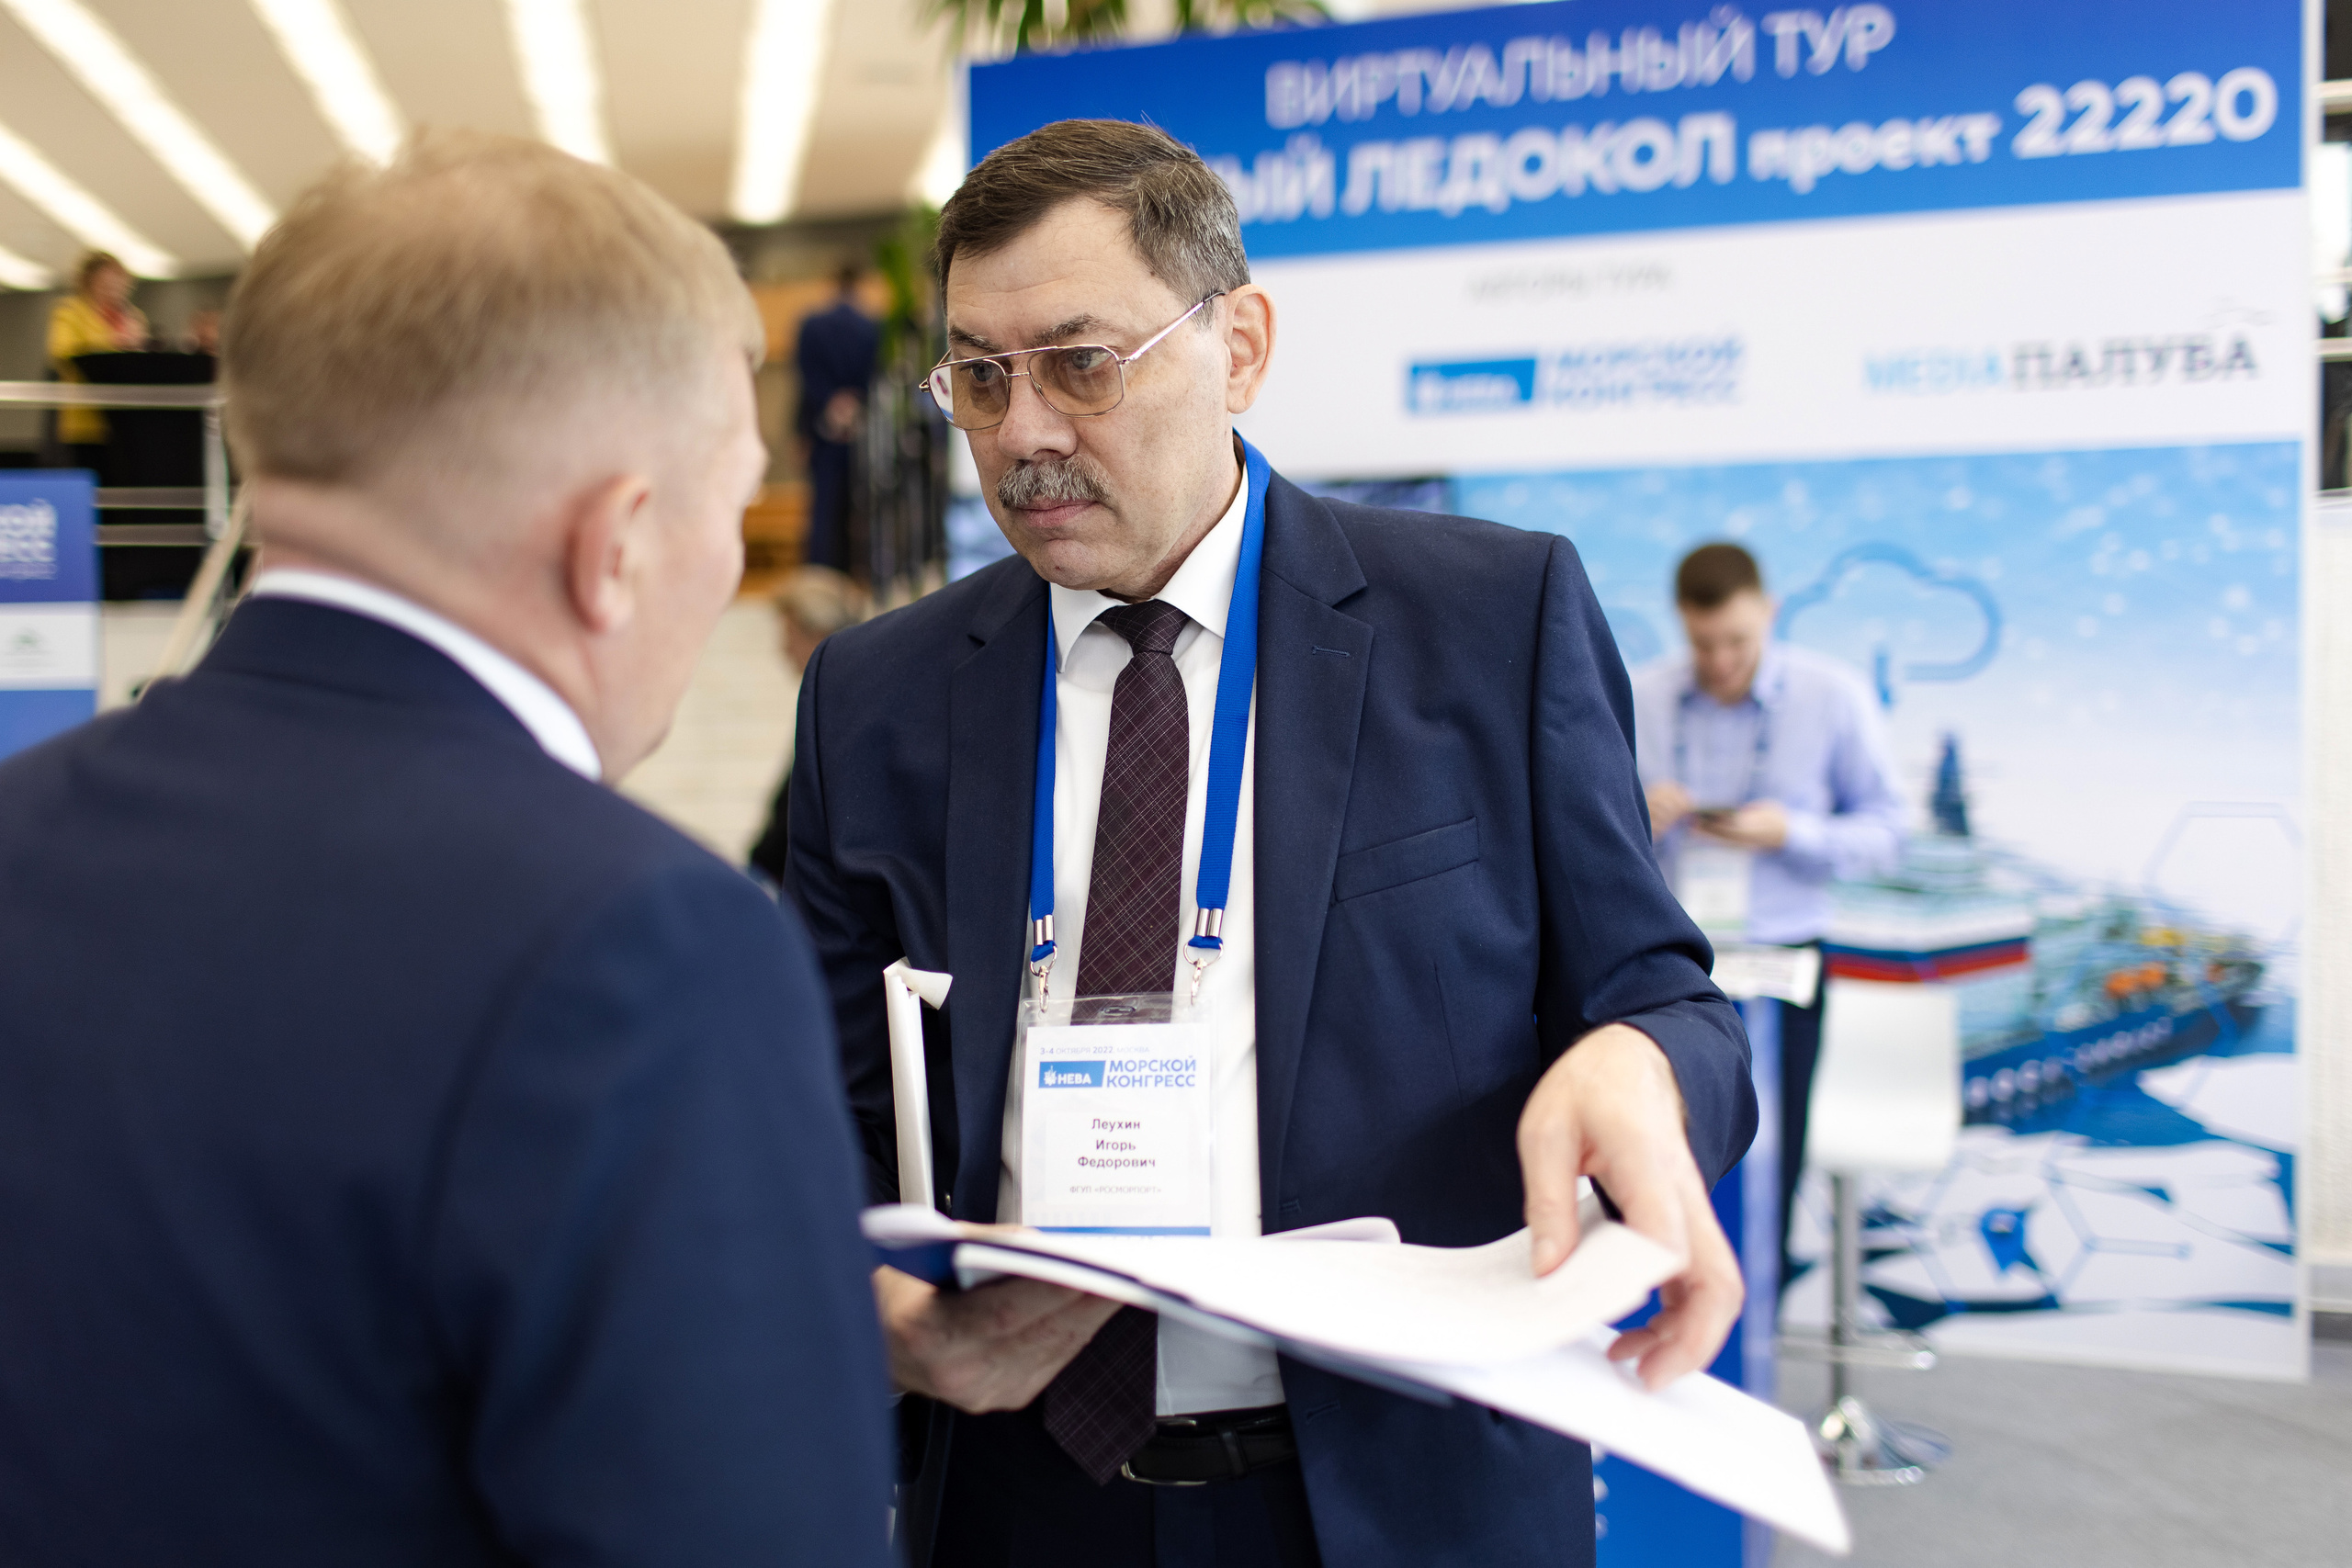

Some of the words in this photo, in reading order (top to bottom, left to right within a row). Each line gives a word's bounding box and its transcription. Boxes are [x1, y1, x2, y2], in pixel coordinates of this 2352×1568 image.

[1265, 4, 1756, 129] ВИРТУАЛЬНЫЙ
[1762, 2, 1896, 77] ТУР
[1205, 132, 1336, 223] ЫЙ
[1342, 111, 1736, 219] ЛЕДОКОЛ
[1749, 112, 2001, 194] проект
[2010, 67, 2278, 160] 22220
[1109, 1055, 1197, 1073] МОРСКОЙ
[1057, 1073, 1092, 1085] НЕВА
[1106, 1074, 1196, 1089] КОНГРЕСС
[1091, 1118, 1141, 1132] Леухин
[1095, 1139, 1136, 1152] Игорь
[1077, 1156, 1156, 1169] Федорович
